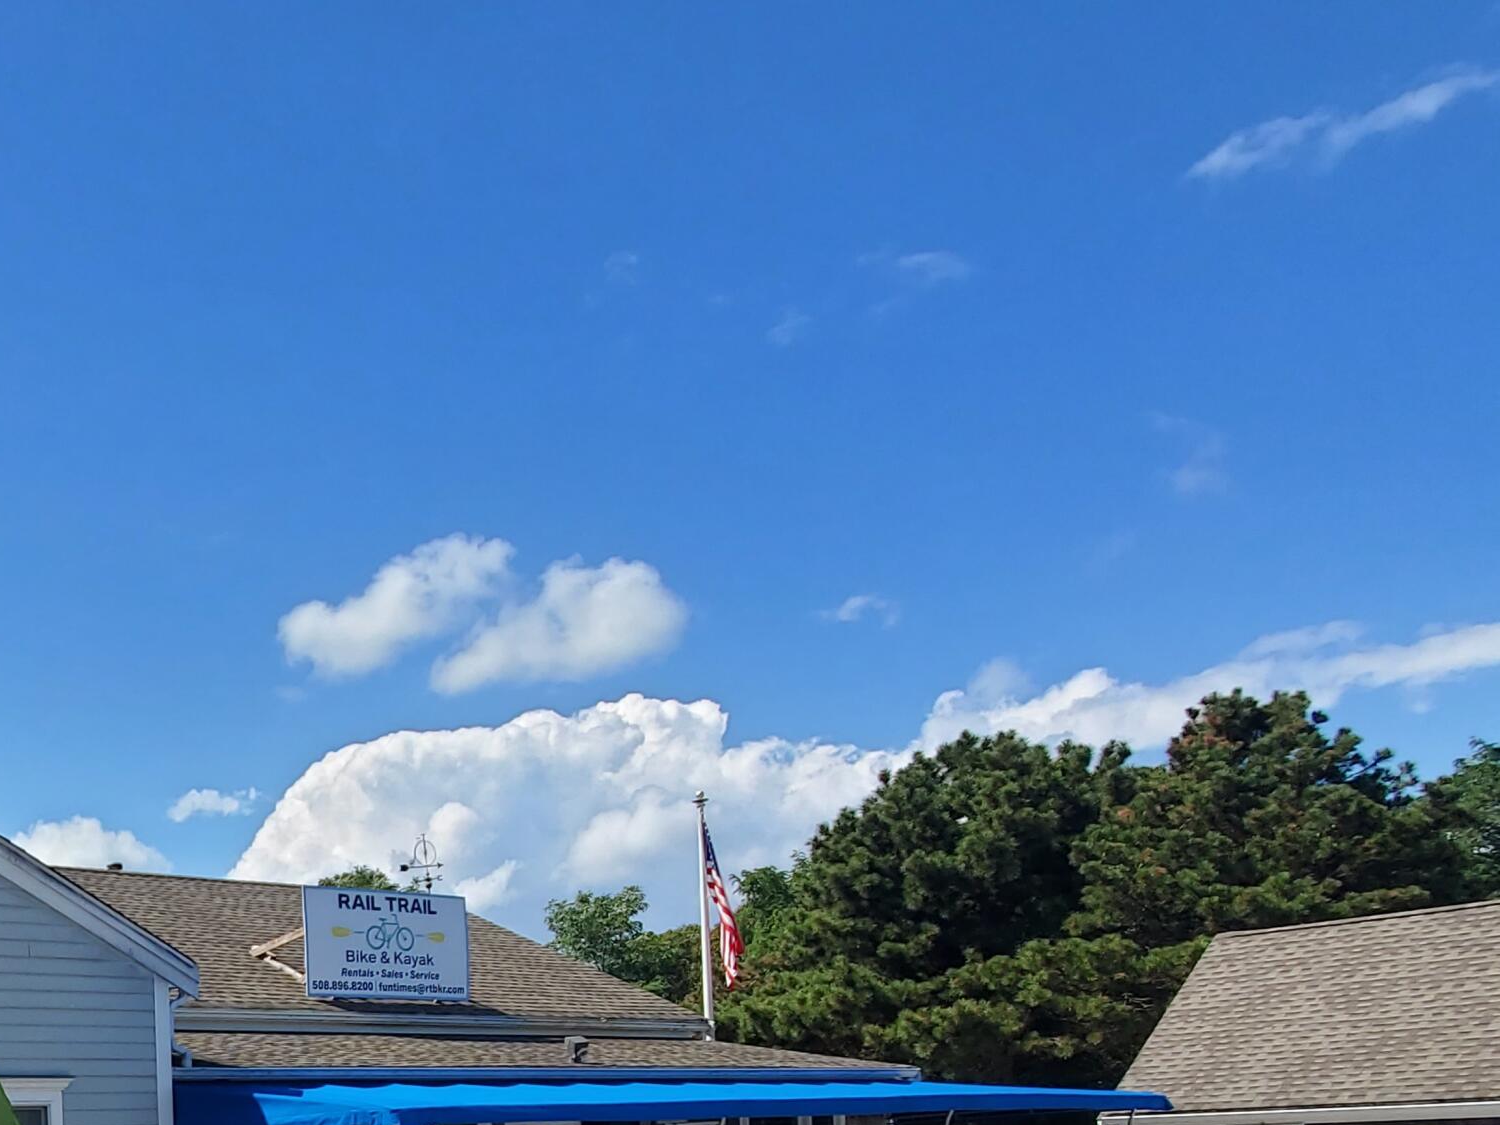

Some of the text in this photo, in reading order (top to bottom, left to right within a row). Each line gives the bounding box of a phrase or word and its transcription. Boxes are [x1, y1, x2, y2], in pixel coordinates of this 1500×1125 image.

[338, 893, 437, 915] RAIL TRAIL
[346, 950, 434, 968] Bike & Kayak
[341, 967, 440, 980] Rentals Sales Service
[312, 979, 465, 996] 508.896.8200 funtimes@rtbkr.com
